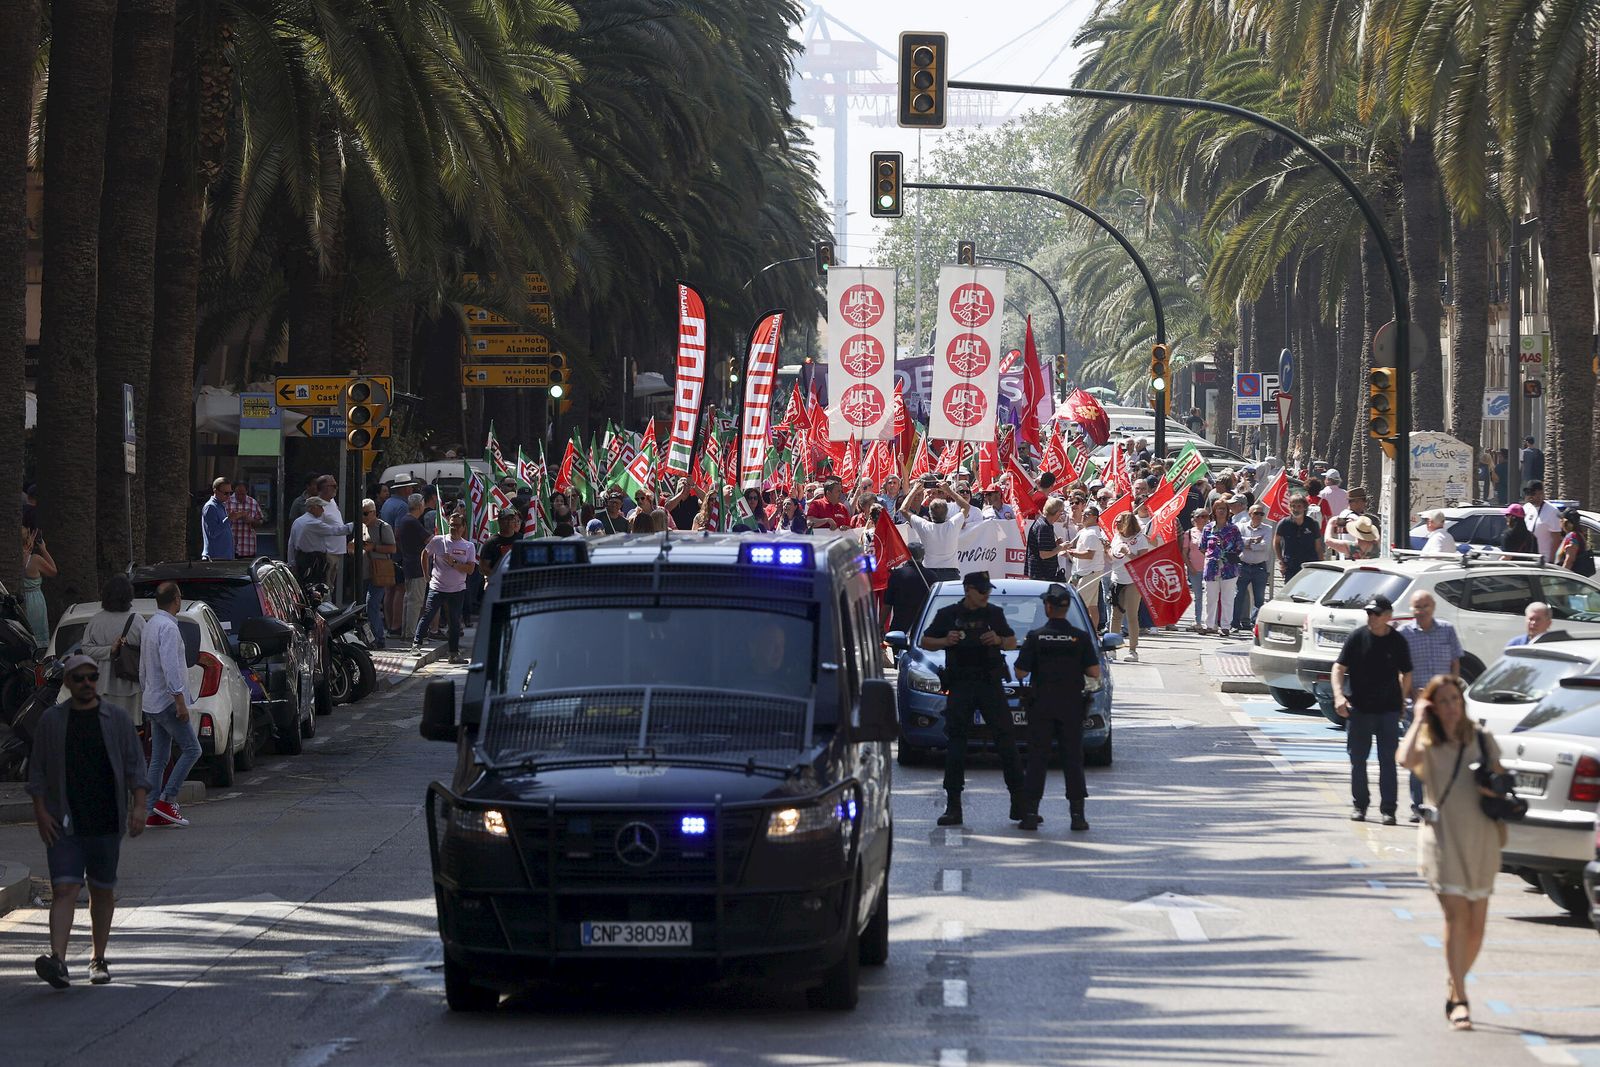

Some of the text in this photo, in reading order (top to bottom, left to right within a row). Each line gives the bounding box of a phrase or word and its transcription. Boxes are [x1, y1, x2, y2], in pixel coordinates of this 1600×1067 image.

[849, 291, 875, 306] UGT
[959, 290, 985, 306] UGT
[849, 341, 875, 356] UGT
[956, 339, 982, 355] UGT
[505, 376, 546, 384] Mariposa
[850, 390, 875, 405] UGT
[952, 389, 978, 405] UGT
[1157, 564, 1183, 595] UGT
